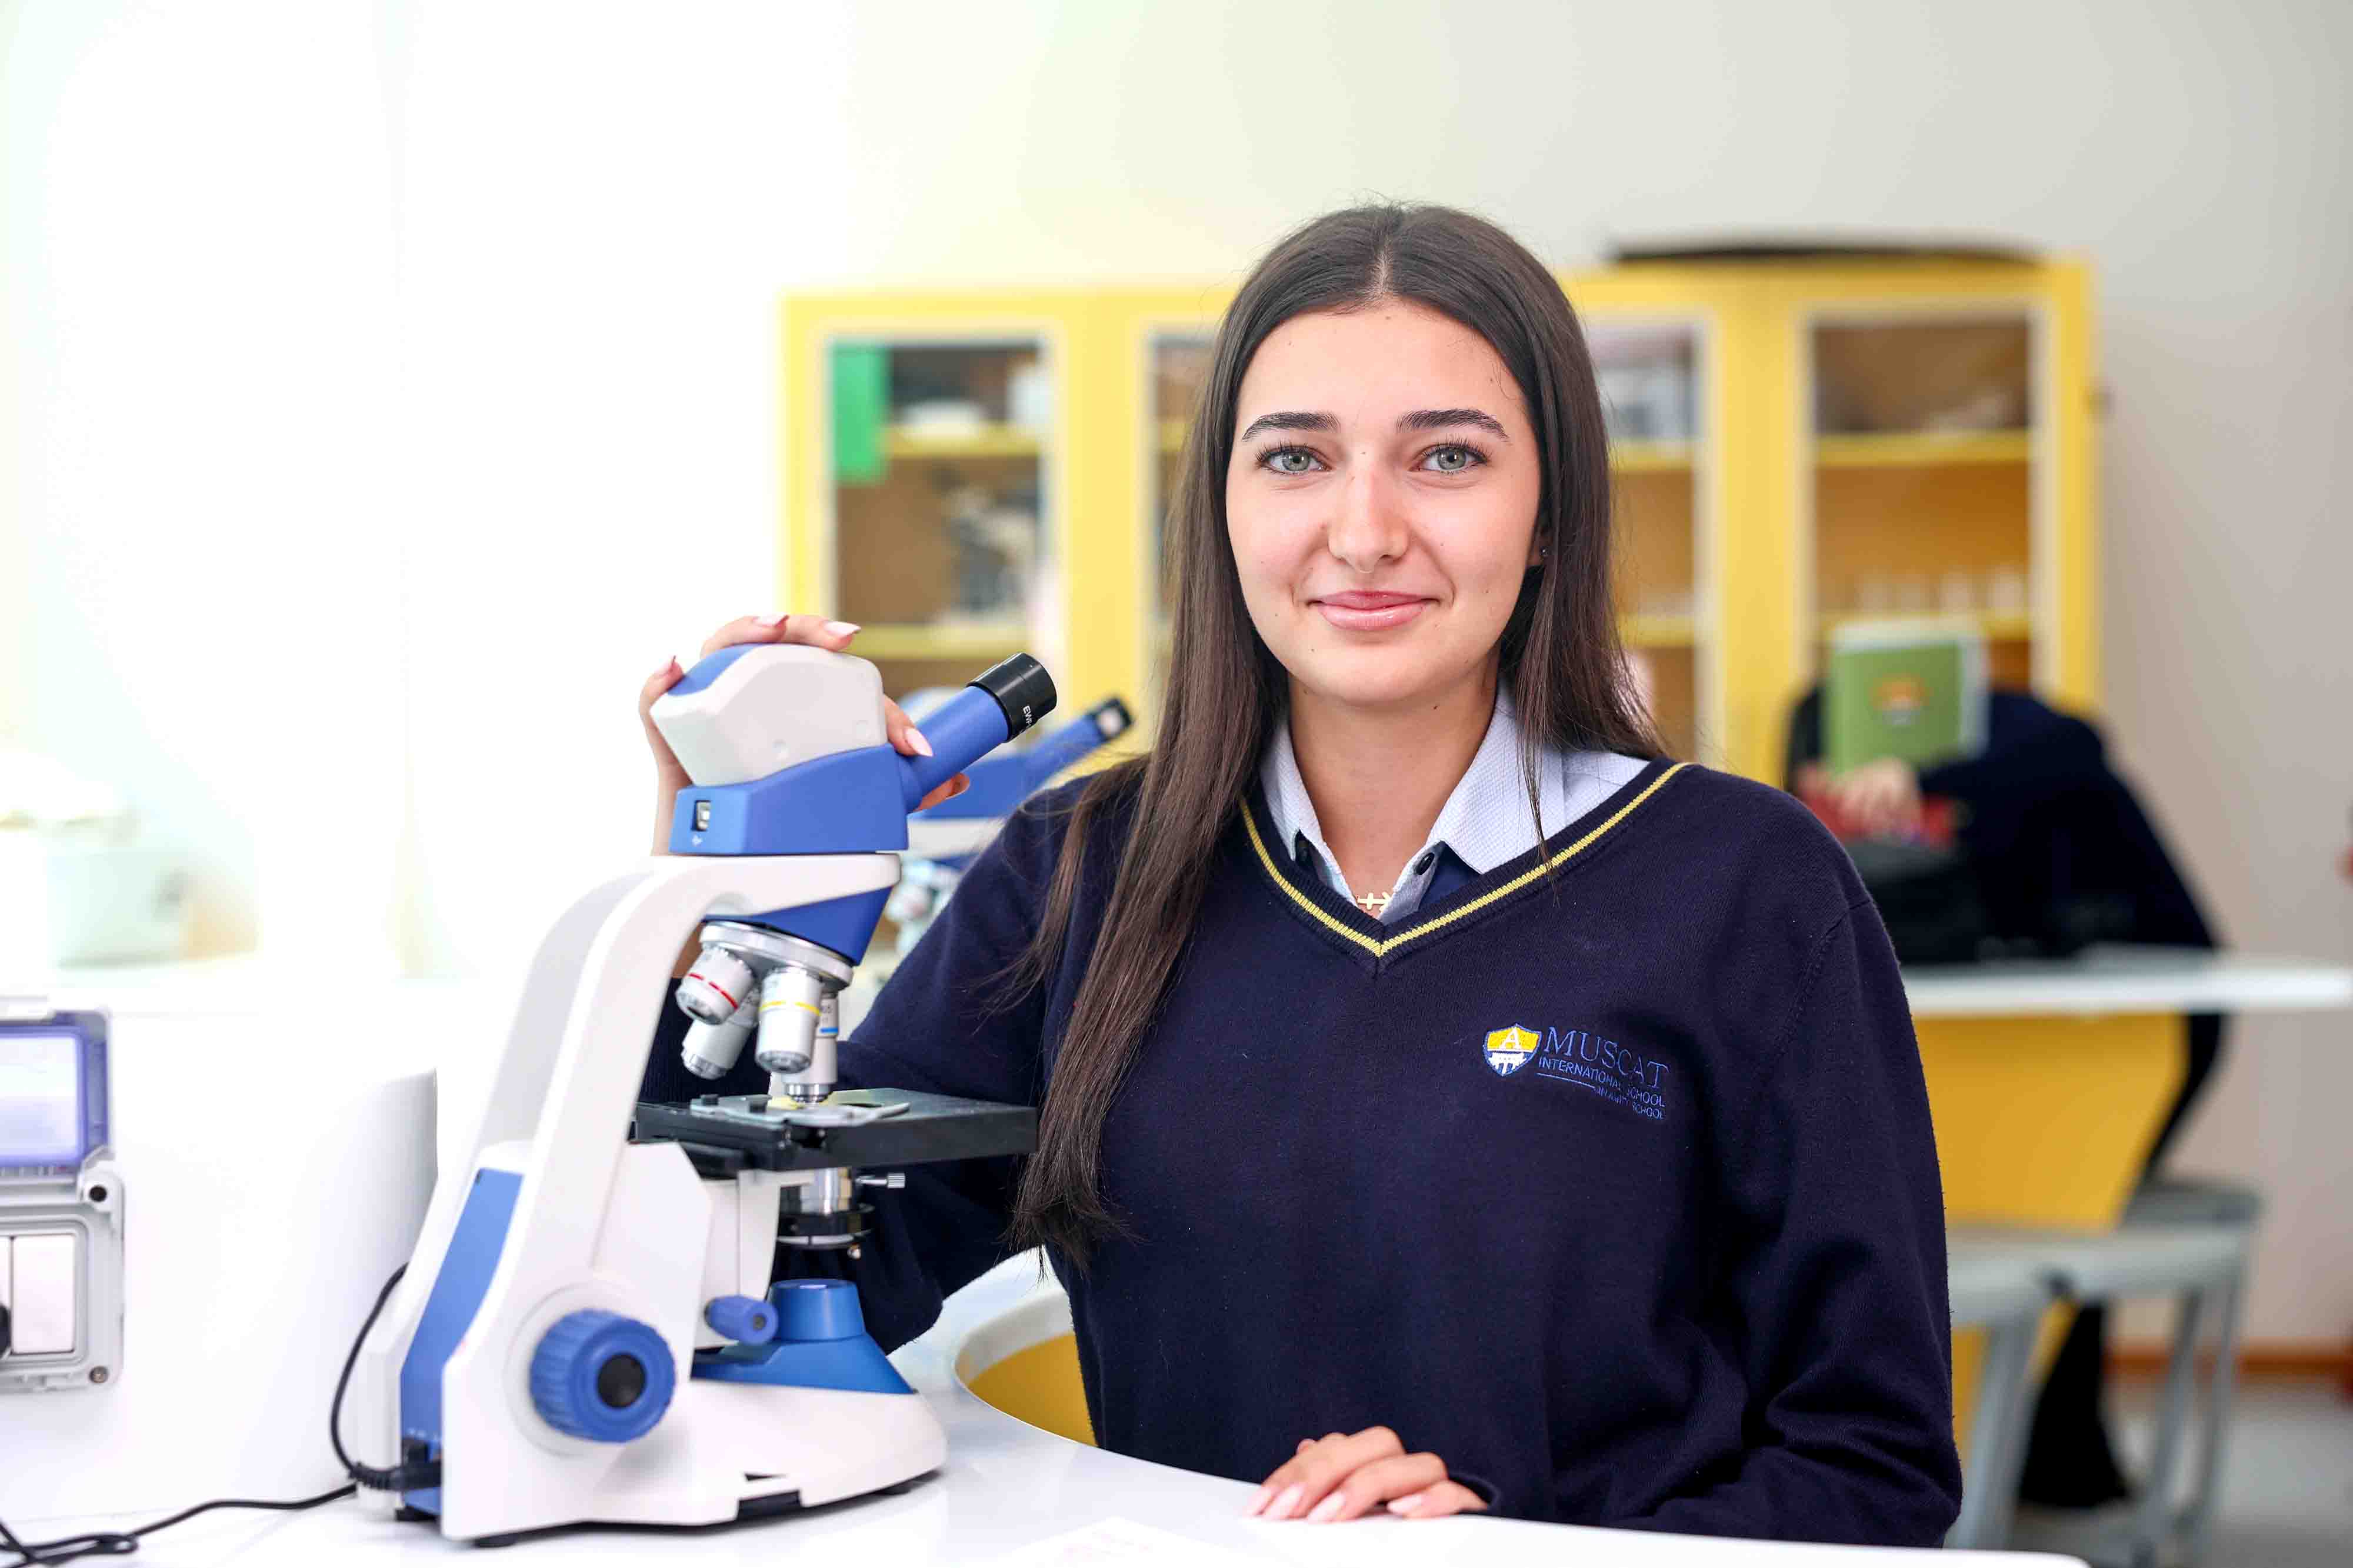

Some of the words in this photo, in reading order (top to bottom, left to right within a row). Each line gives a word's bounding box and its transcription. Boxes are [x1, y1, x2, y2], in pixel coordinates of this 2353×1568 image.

[1538, 1056, 1622, 1092] INTERNATIONAL
[1626, 1084, 1666, 1107] SCHOOL
[1543, 1026, 1670, 1088] MUSCAT
